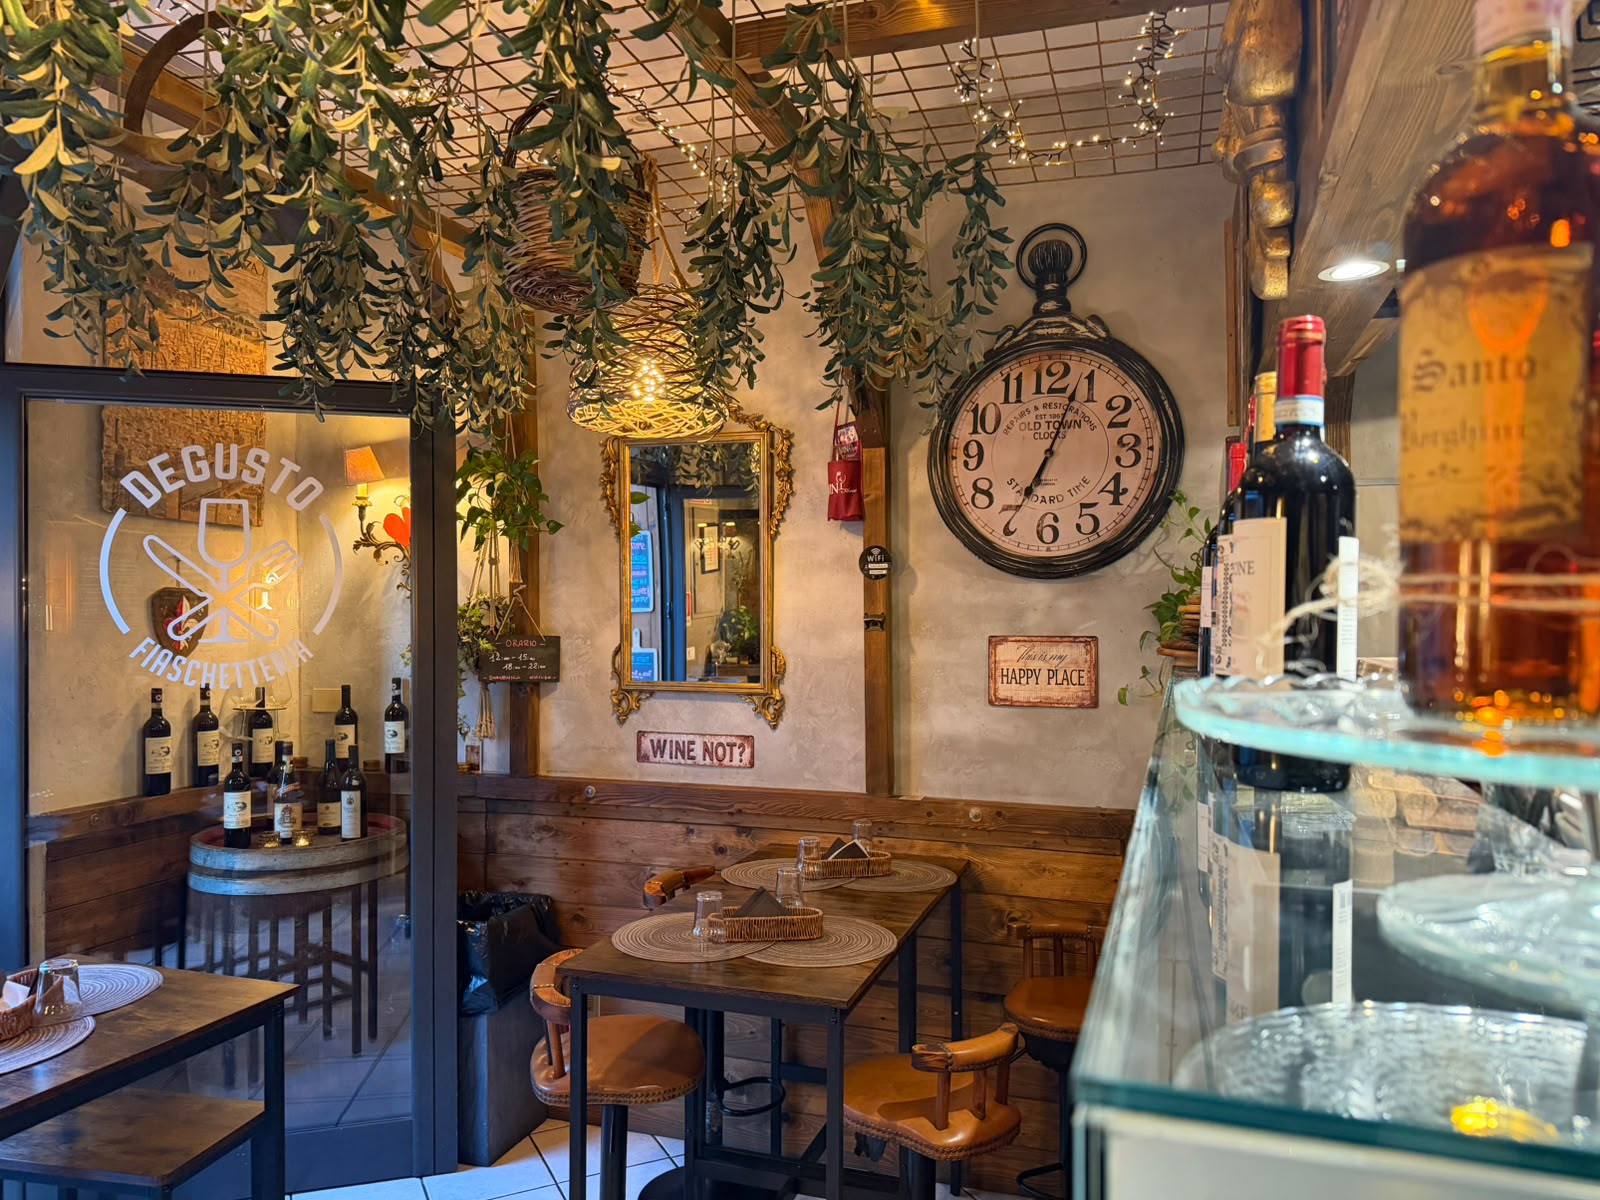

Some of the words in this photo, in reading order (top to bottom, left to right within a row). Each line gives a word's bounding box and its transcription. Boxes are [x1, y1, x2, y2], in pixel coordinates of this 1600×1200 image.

[1000, 371, 1023, 404] 11
[1032, 360, 1071, 395] 12
[1083, 369, 1097, 403] 1
[968, 401, 1001, 435] 10
[1003, 407, 1031, 436] REPAIRS
[1019, 421, 1041, 432] OLD
[1045, 419, 1082, 431] TOWN
[1105, 395, 1133, 429] 2
[963, 439, 984, 471] 9
[1115, 433, 1142, 468] 3
[120, 443, 324, 511] DEGUSTO
[971, 477, 994, 509] 8
[1066, 475, 1091, 498] TIME
[1098, 472, 1129, 506] 4
[998, 504, 1023, 536] 7
[1036, 512, 1060, 544] 6
[1075, 502, 1100, 535] 5
[505, 639, 537, 648] ORARIO
[1016, 644, 1037, 663] This
[1038, 651, 1048, 661] is
[1049, 654, 1068, 668] my
[129, 636, 314, 690] FIASCHETTERIA
[1000, 667, 1041, 685] HAPPY
[1046, 668, 1086, 686] PLACE
[649, 739, 696, 761] WINE
[702, 740, 746, 763] NOT?
